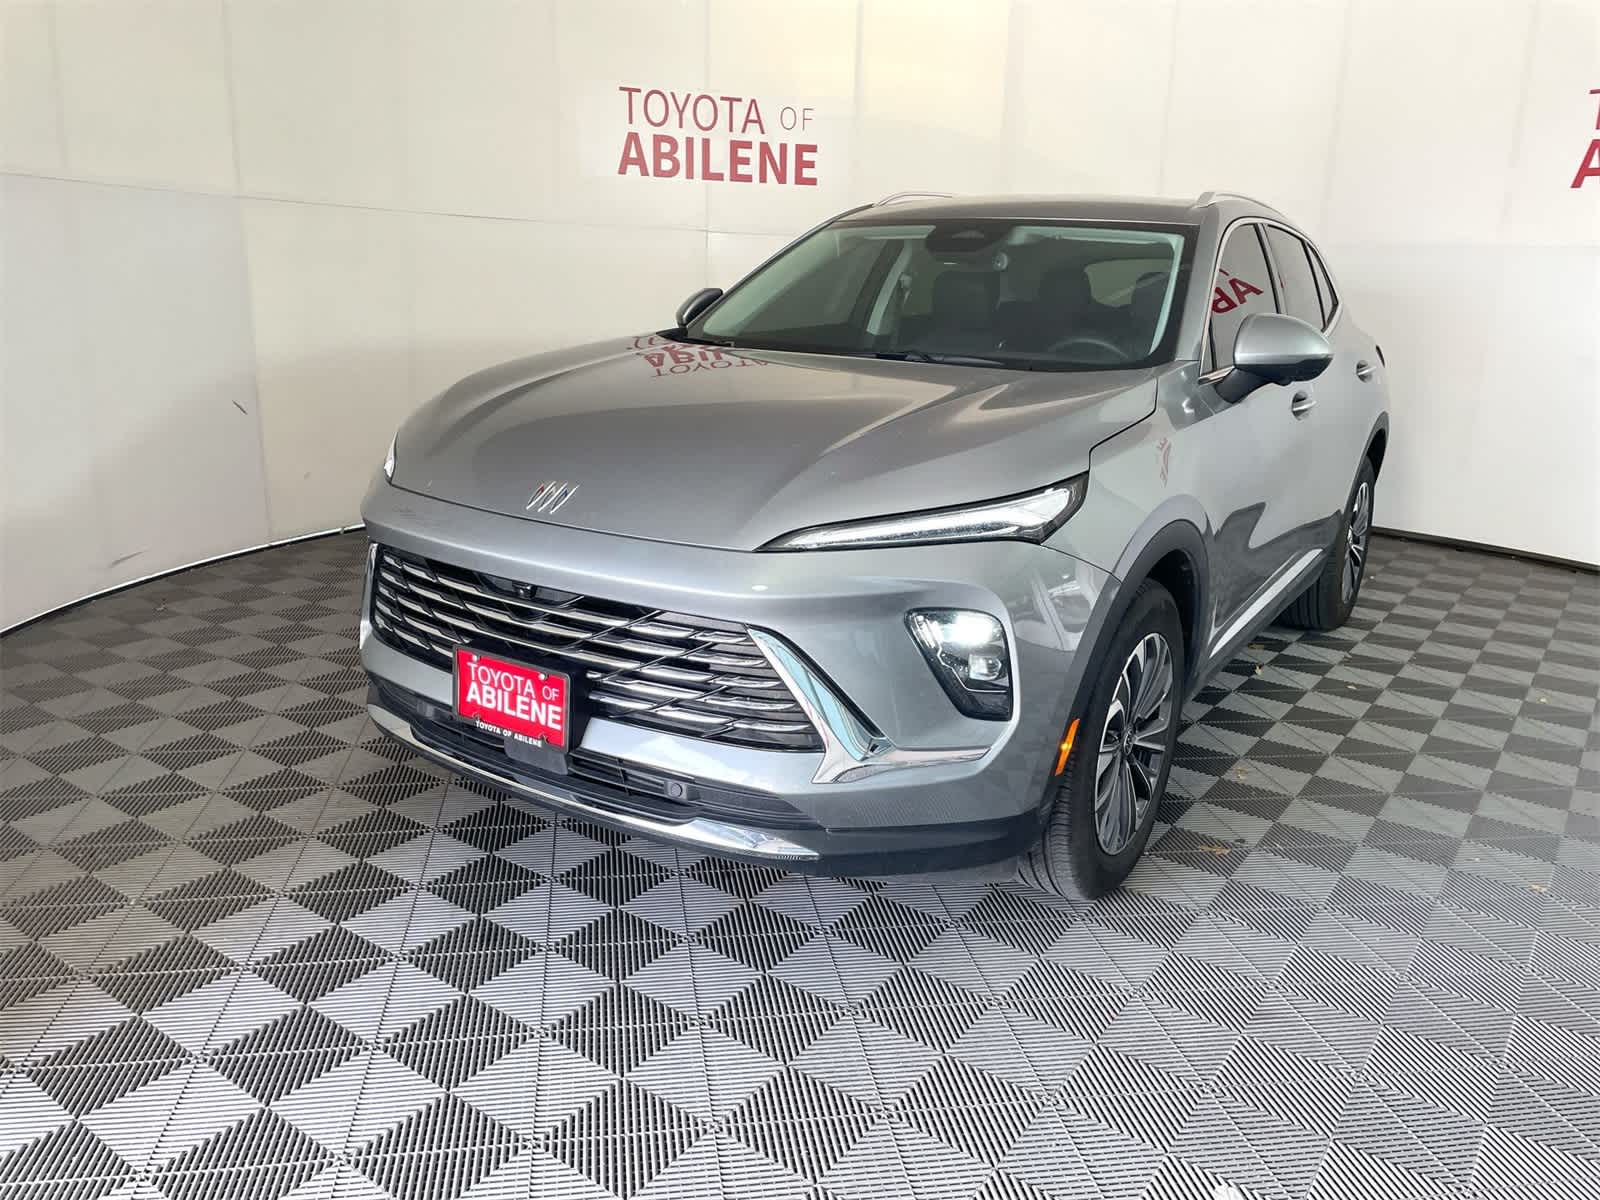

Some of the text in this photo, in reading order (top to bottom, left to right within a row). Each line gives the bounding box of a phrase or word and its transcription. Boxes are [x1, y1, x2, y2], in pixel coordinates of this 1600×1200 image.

[618, 86, 815, 135] TOYOTA OF
[617, 131, 818, 186] ABILENE
[466, 681, 562, 730] ABILENE
[467, 662, 559, 700] TOYOTA OF
[475, 720, 501, 734] TOYOTA
[513, 733, 542, 747] ABILENE
